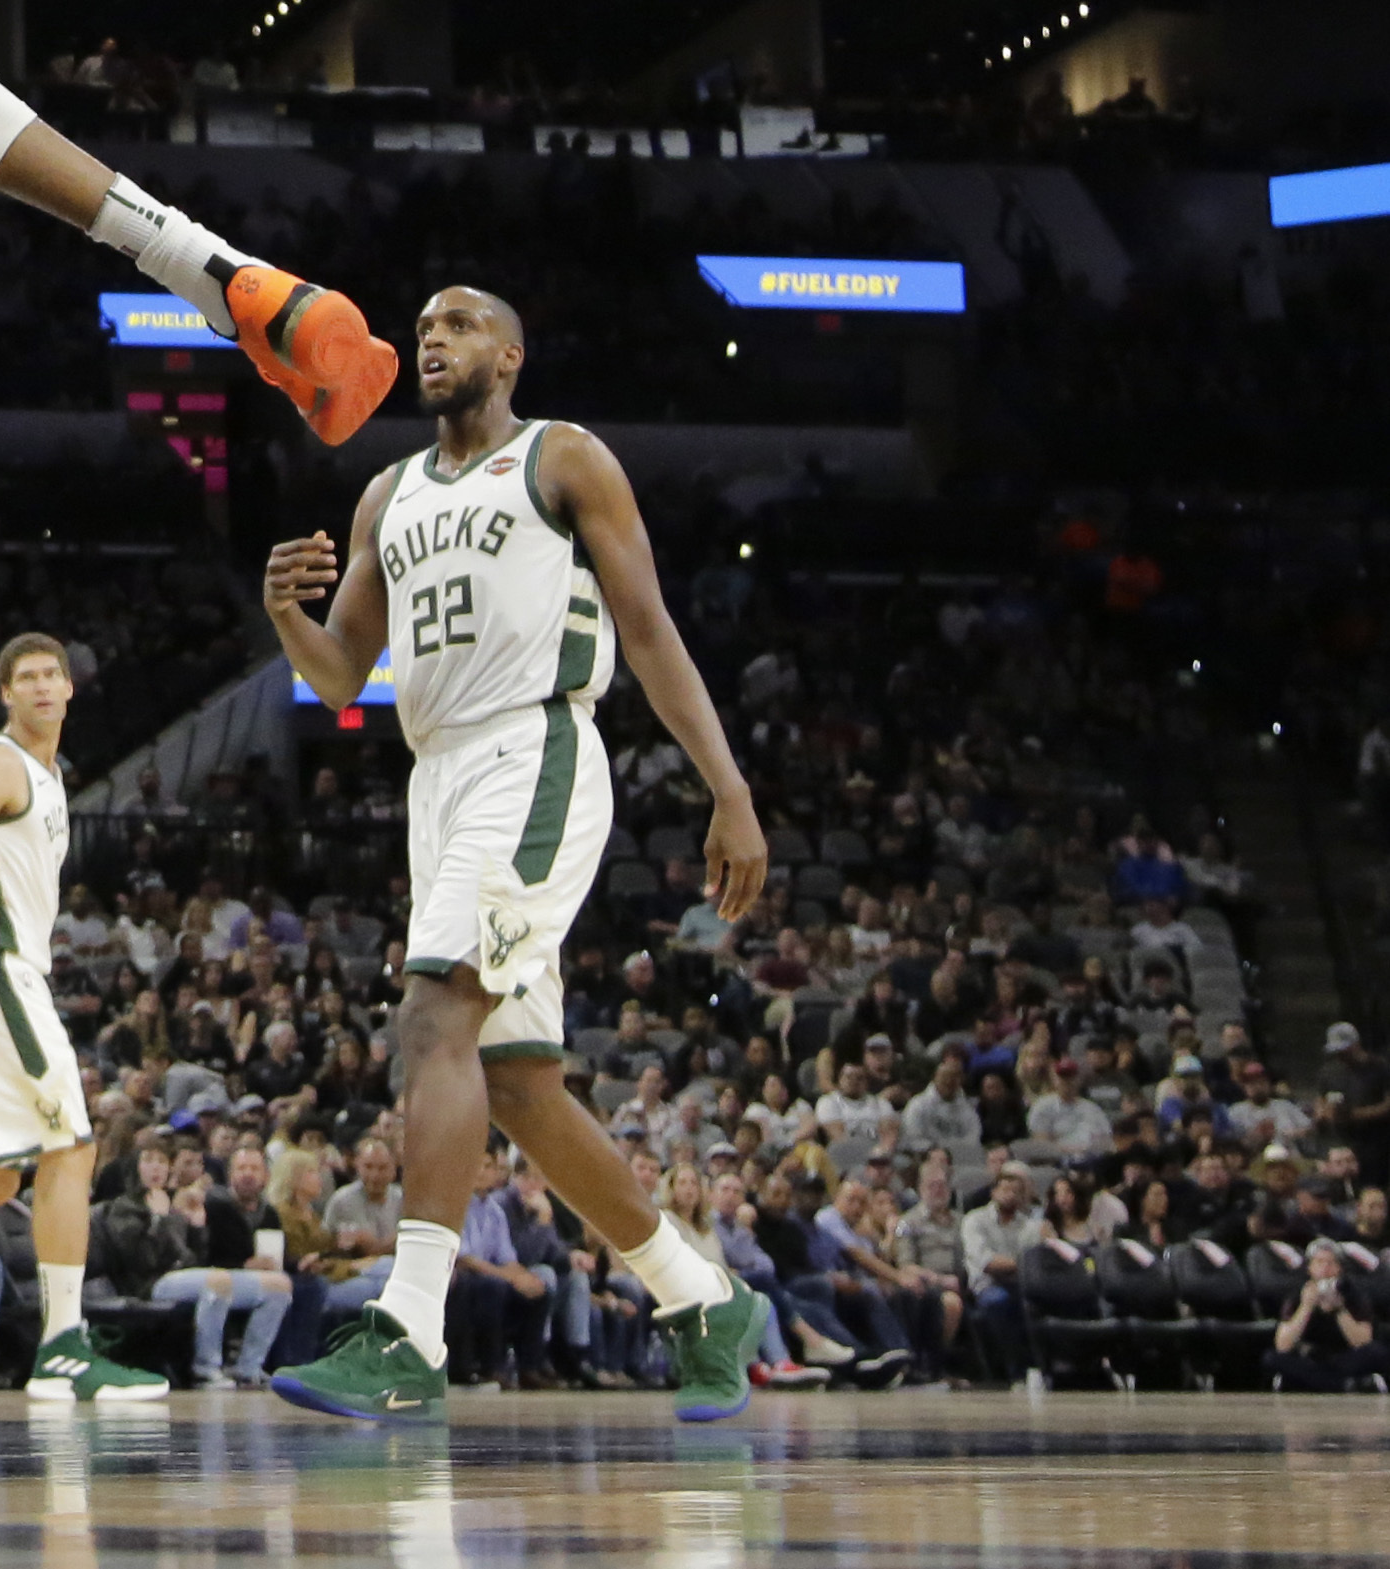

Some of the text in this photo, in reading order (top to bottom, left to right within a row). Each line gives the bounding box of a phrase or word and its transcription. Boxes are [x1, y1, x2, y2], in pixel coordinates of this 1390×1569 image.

[760, 272, 899, 297] #FUELEDBY
[382, 505, 517, 585] BUCKS
[411, 573, 477, 659] 22
